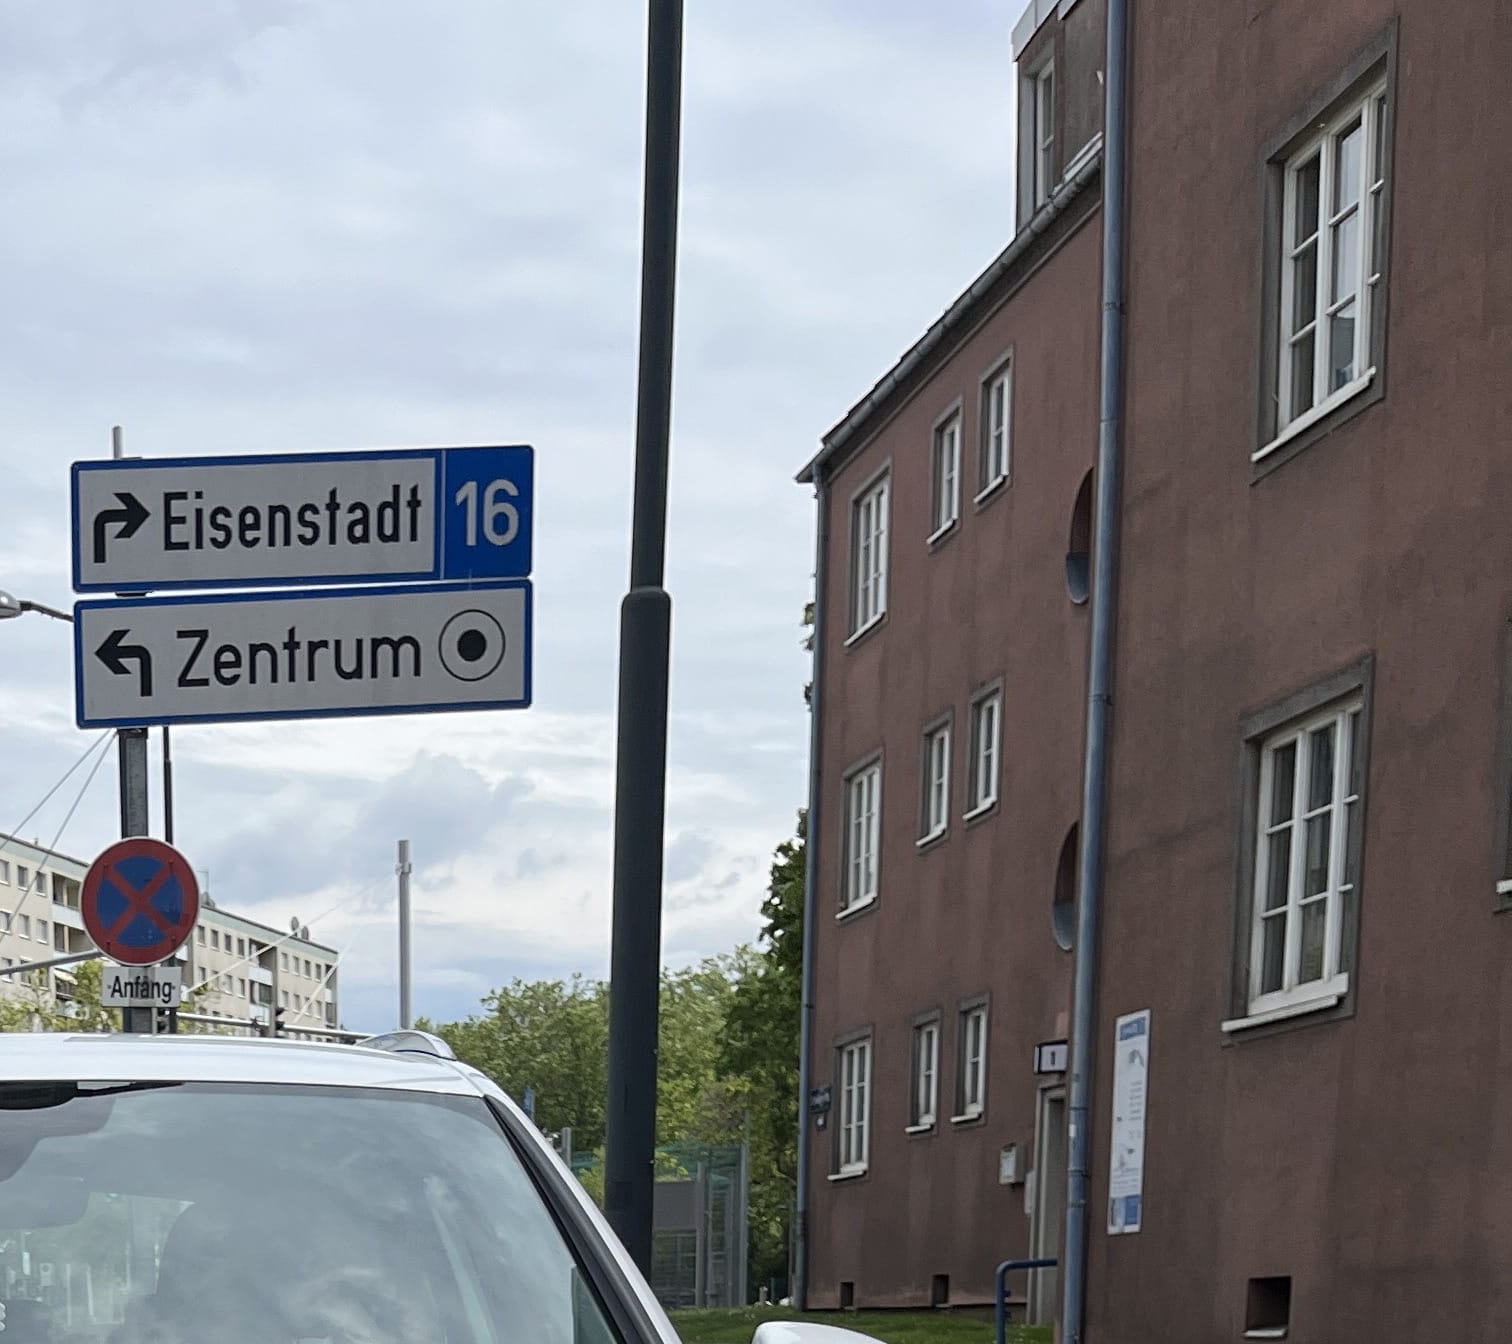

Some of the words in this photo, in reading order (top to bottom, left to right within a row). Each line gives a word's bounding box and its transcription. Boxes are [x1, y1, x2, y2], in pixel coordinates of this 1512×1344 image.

[163, 484, 422, 551] Eisenstadt
[455, 479, 520, 547] 16
[176, 626, 422, 687] Zentrum
[110, 975, 173, 1004] Anfang
